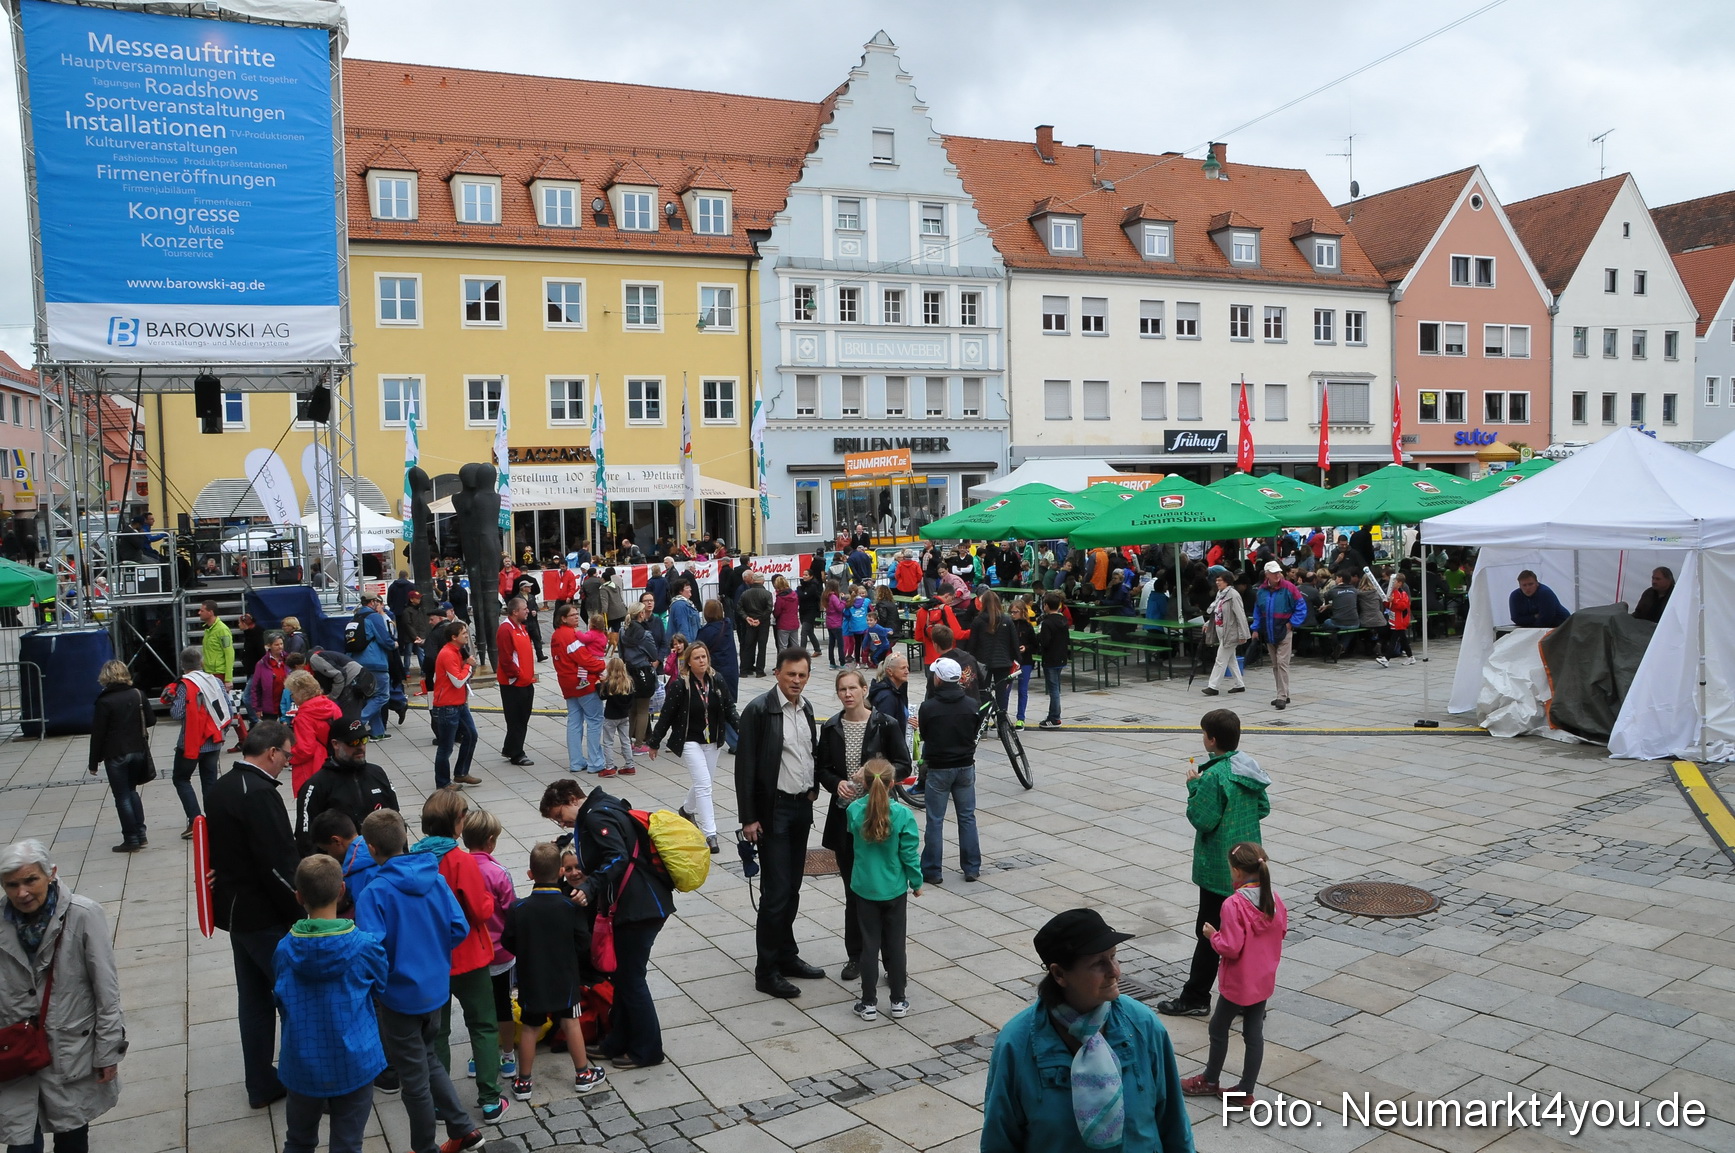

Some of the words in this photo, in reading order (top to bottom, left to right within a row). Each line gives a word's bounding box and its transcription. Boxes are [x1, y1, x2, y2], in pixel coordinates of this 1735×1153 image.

[88, 31, 276, 68] Messeauftritte
[61, 53, 237, 82] Hauptversammlungen
[92, 77, 141, 90] Tagungen
[241, 73, 256, 82] Get
[259, 74, 298, 86] together
[145, 78, 259, 102] Roadshows
[85, 92, 286, 123] Sportveranstaltungen
[65, 111, 227, 140] Installationen
[230, 129, 305, 142] TV-Produktionen
[85, 136, 238, 157] Kulturveranstaltungen
[113, 154, 178, 165] Fashionshows
[184, 157, 288, 171] Produktpräsentationen
[97, 165, 276, 191] Firmeneröffnungen
[122, 184, 197, 196] Firmenjubiläum
[194, 197, 252, 208] Firmenfeiern
[128, 202, 240, 227] Kongresse
[189, 225, 235, 236] Musicals
[141, 233, 224, 250] Konzerte
[163, 249, 214, 258] Tourservice
[127, 277, 265, 293] www.barowski-ag.de
[146, 322, 255, 339] BAROWSKI
[261, 323, 290, 339] AG
[147, 339, 210, 348] Veranstaltungs-
[231, 340, 289, 348] Mediensysteme
[844, 341, 895, 356] BRILLEN
[896, 343, 942, 357] WEBER
[833, 437, 893, 454] BRILLEN
[895, 436, 951, 454] WEBER
[1167, 431, 1226, 452] frühauf
[1454, 427, 1498, 446] sutor
[565, 471, 584, 483] 100
[642, 470, 685, 481] Weltkrie
[1131, 516, 1216, 527] Lammsbräu
[1143, 511, 1205, 519] Neumarkter
